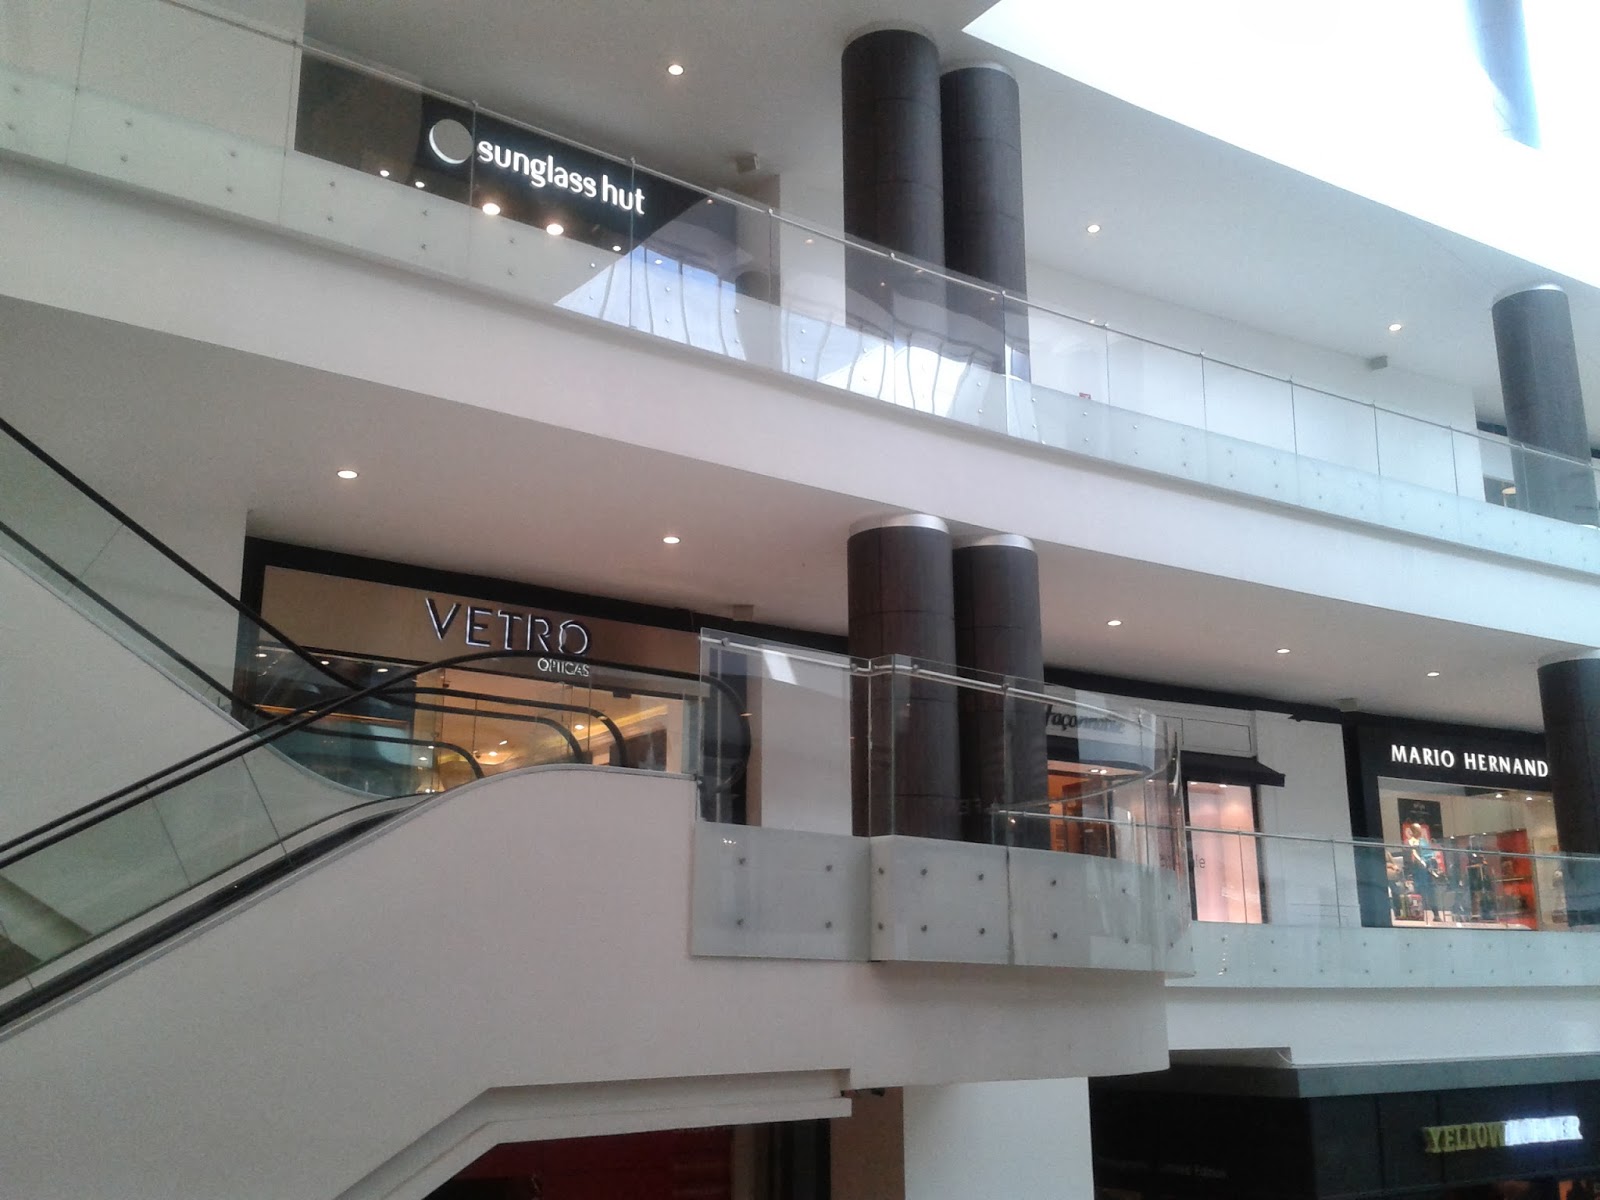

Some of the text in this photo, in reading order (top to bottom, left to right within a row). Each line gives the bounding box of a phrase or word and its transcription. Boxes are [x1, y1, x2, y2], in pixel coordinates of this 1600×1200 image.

[476, 139, 646, 215] sunglass hut
[425, 597, 591, 656] VETRO
[1391, 744, 1549, 778] MARIO HERNAND
[1424, 1121, 1505, 1153] YELLOW
